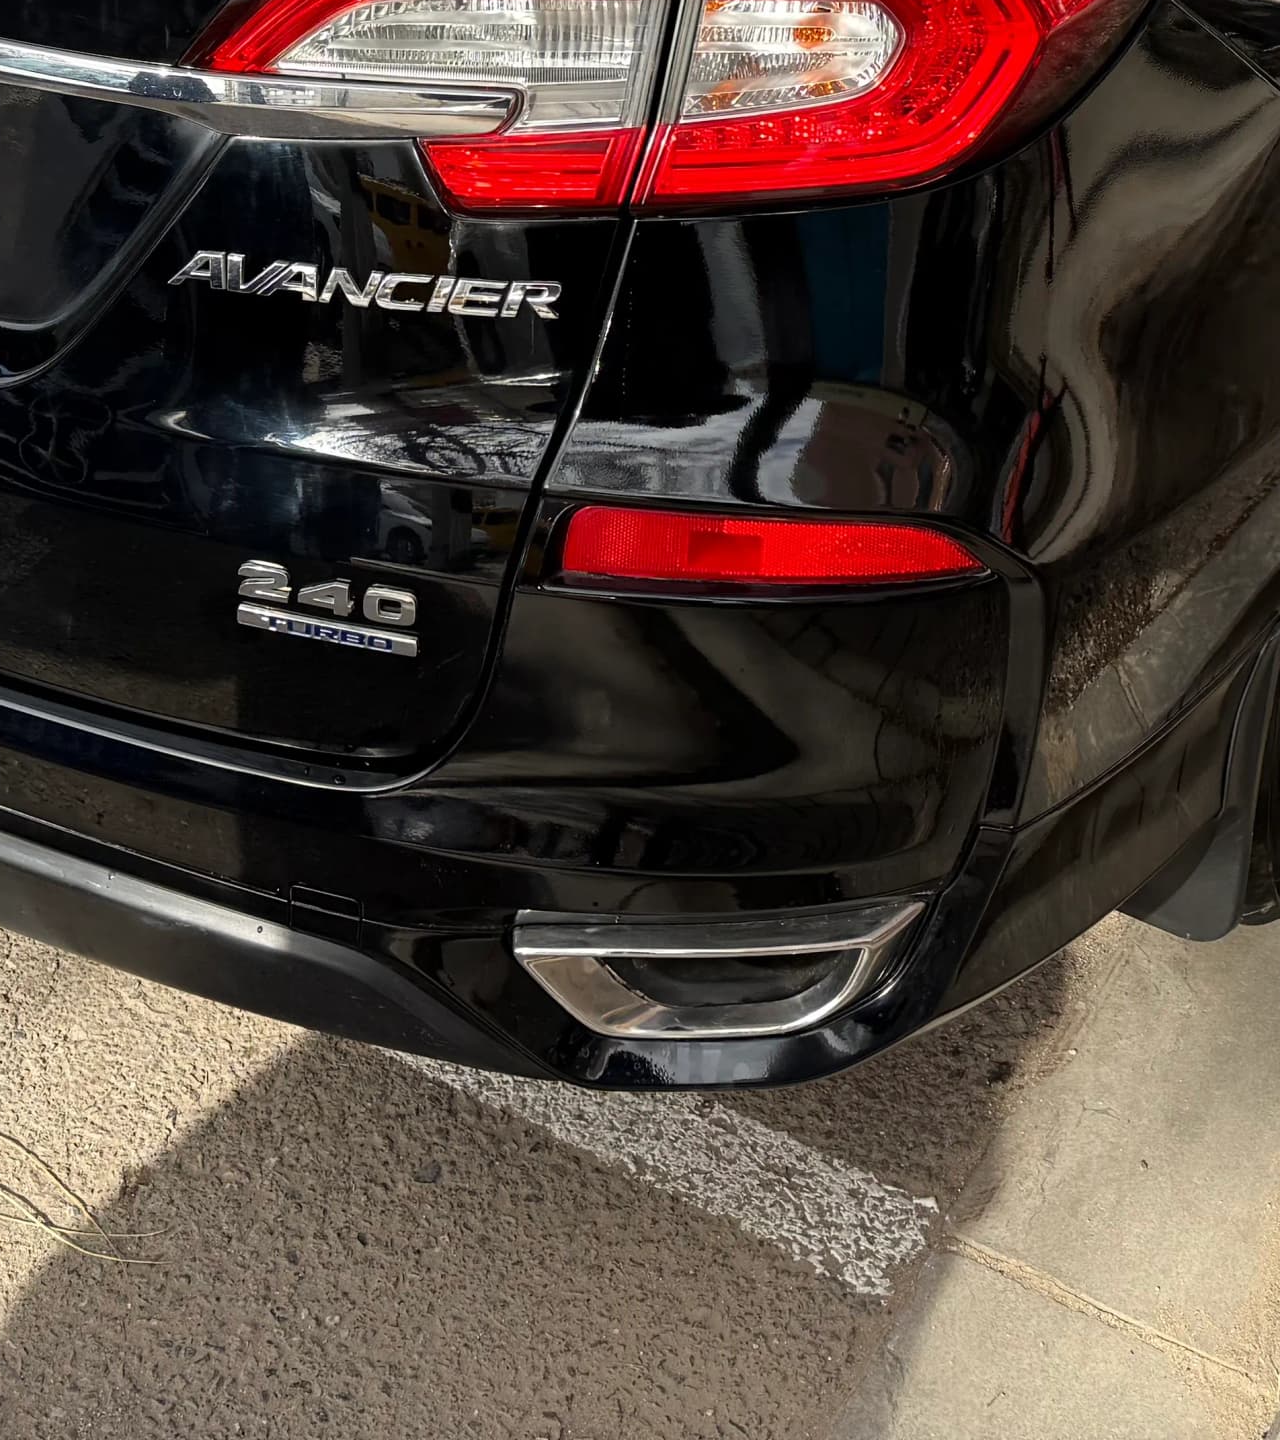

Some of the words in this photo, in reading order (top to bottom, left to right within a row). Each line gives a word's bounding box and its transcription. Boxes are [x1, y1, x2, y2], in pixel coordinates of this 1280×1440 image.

[168, 250, 562, 319] AVANCIER
[238, 560, 417, 626] 240
[260, 615, 393, 654] TURBO
